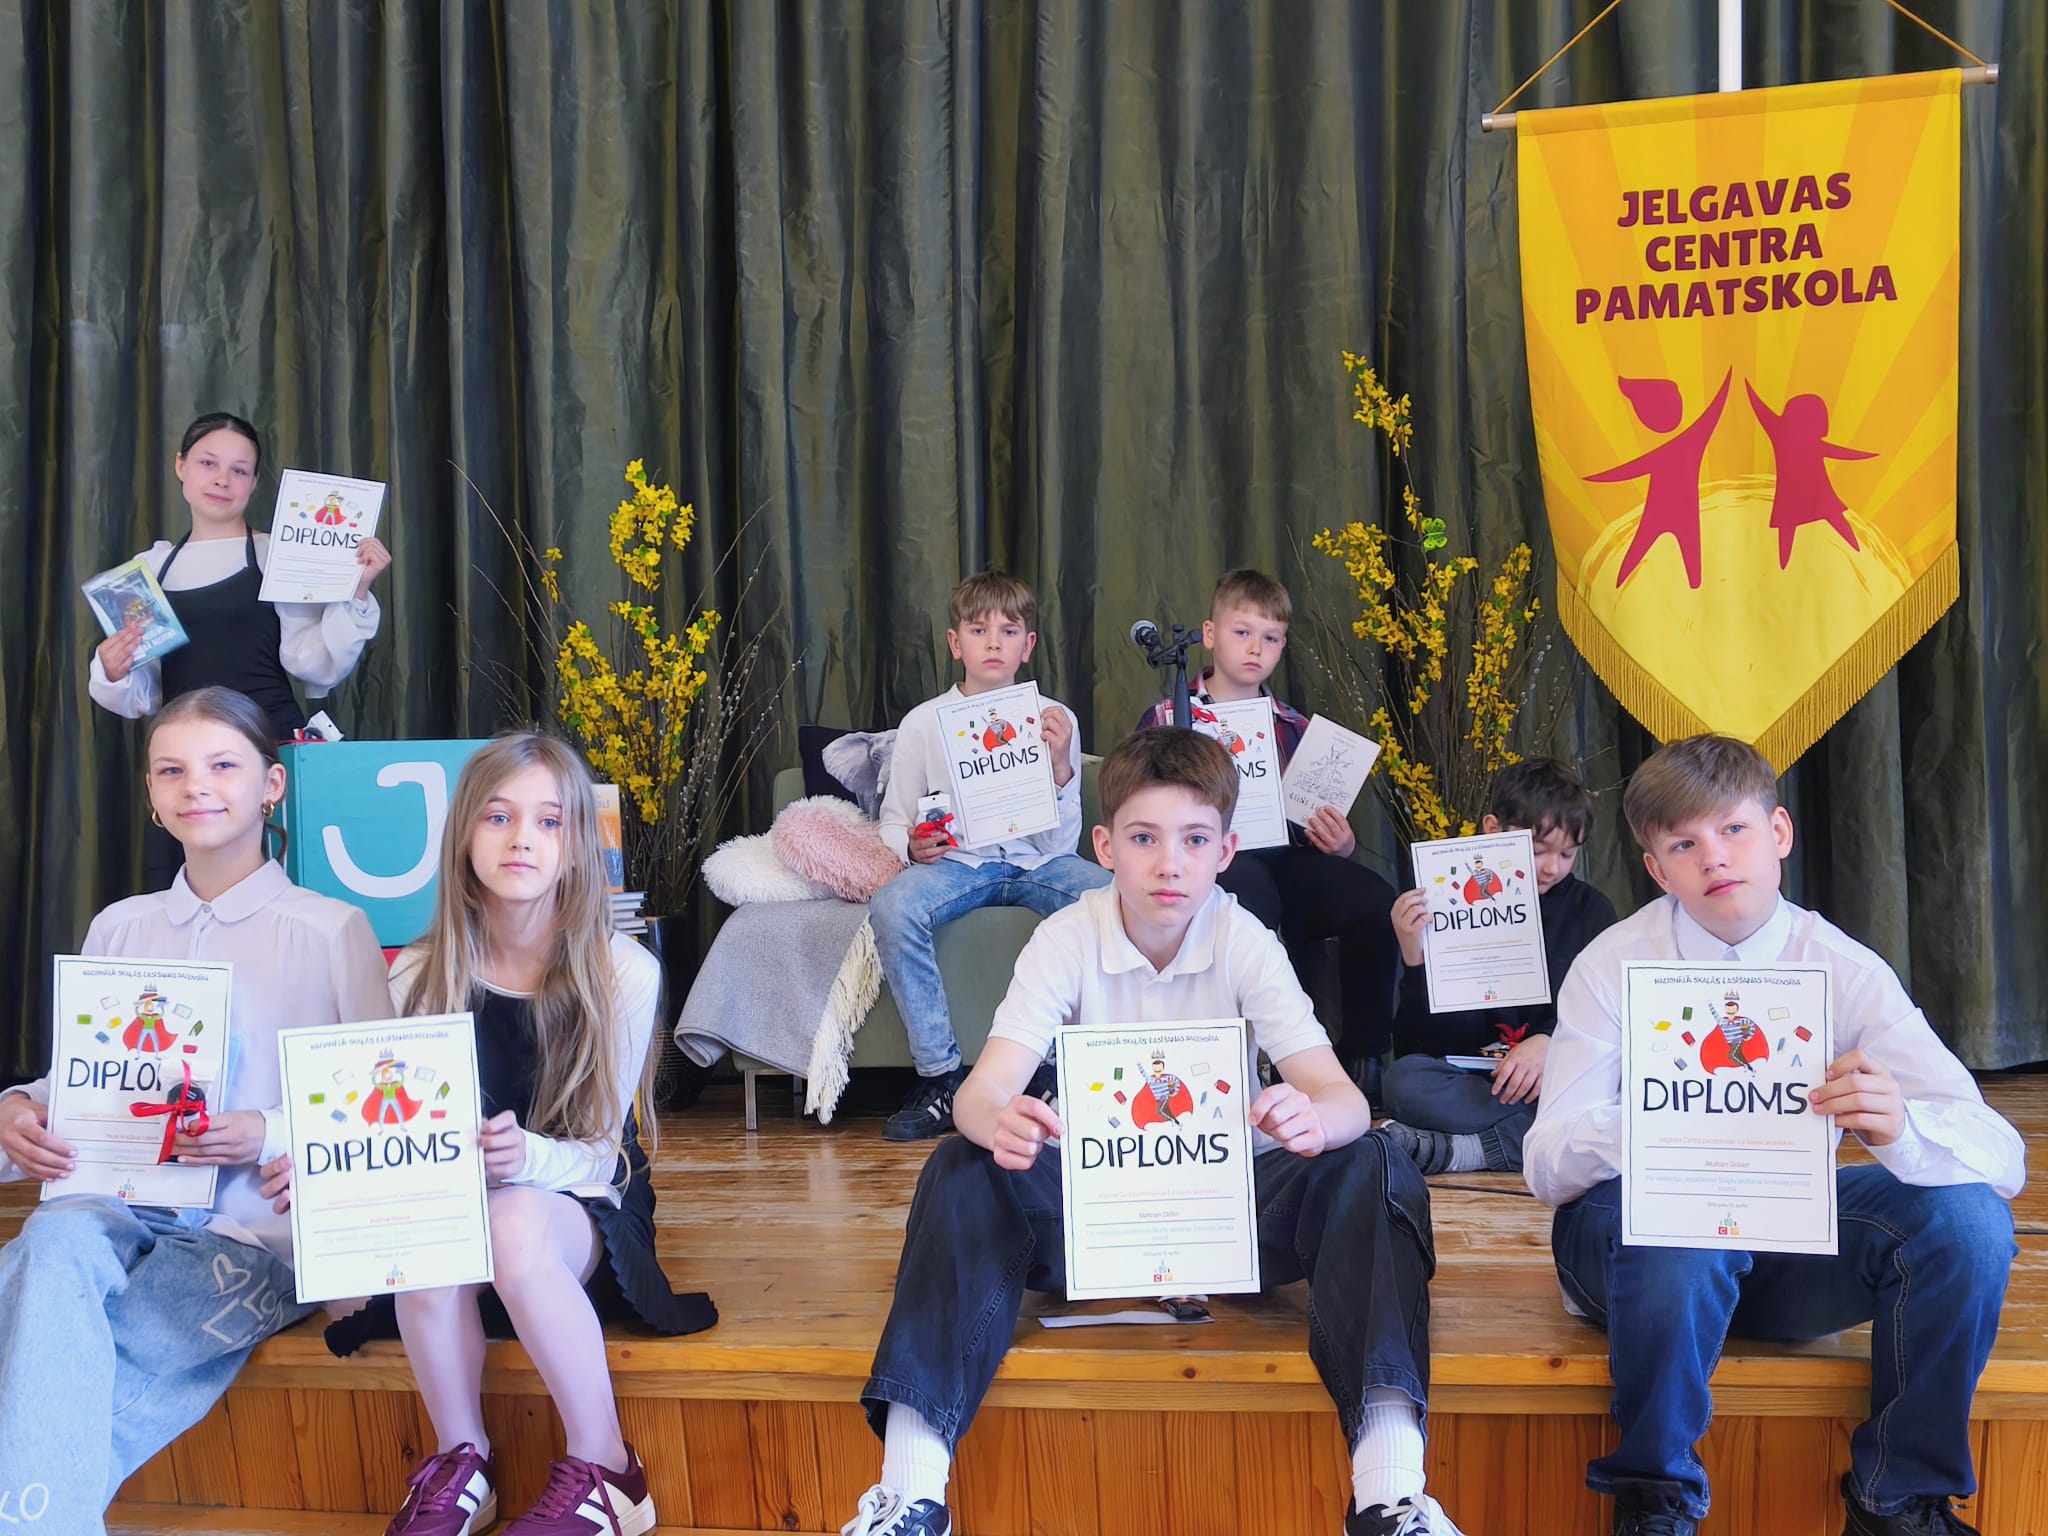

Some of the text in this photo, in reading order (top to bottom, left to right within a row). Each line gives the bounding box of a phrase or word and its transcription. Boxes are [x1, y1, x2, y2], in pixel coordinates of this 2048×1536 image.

[1616, 172, 1852, 228] JELGAVAS
[1645, 223, 1824, 273] CENTRA
[1575, 265, 1898, 325] PAMATSKOLA
[280, 524, 362, 549] DIPLOMS
[958, 745, 1039, 780] DIPLOMS
[322, 761, 448, 899] J
[1433, 903, 1527, 932] DIPLOMS
[67, 1057, 162, 1092] DIPLO
[1643, 1077, 1809, 1115] DIPLOMS
[306, 1131, 461, 1176] DIPLOMS
[1081, 1133, 1229, 1170] DIPLOMS
